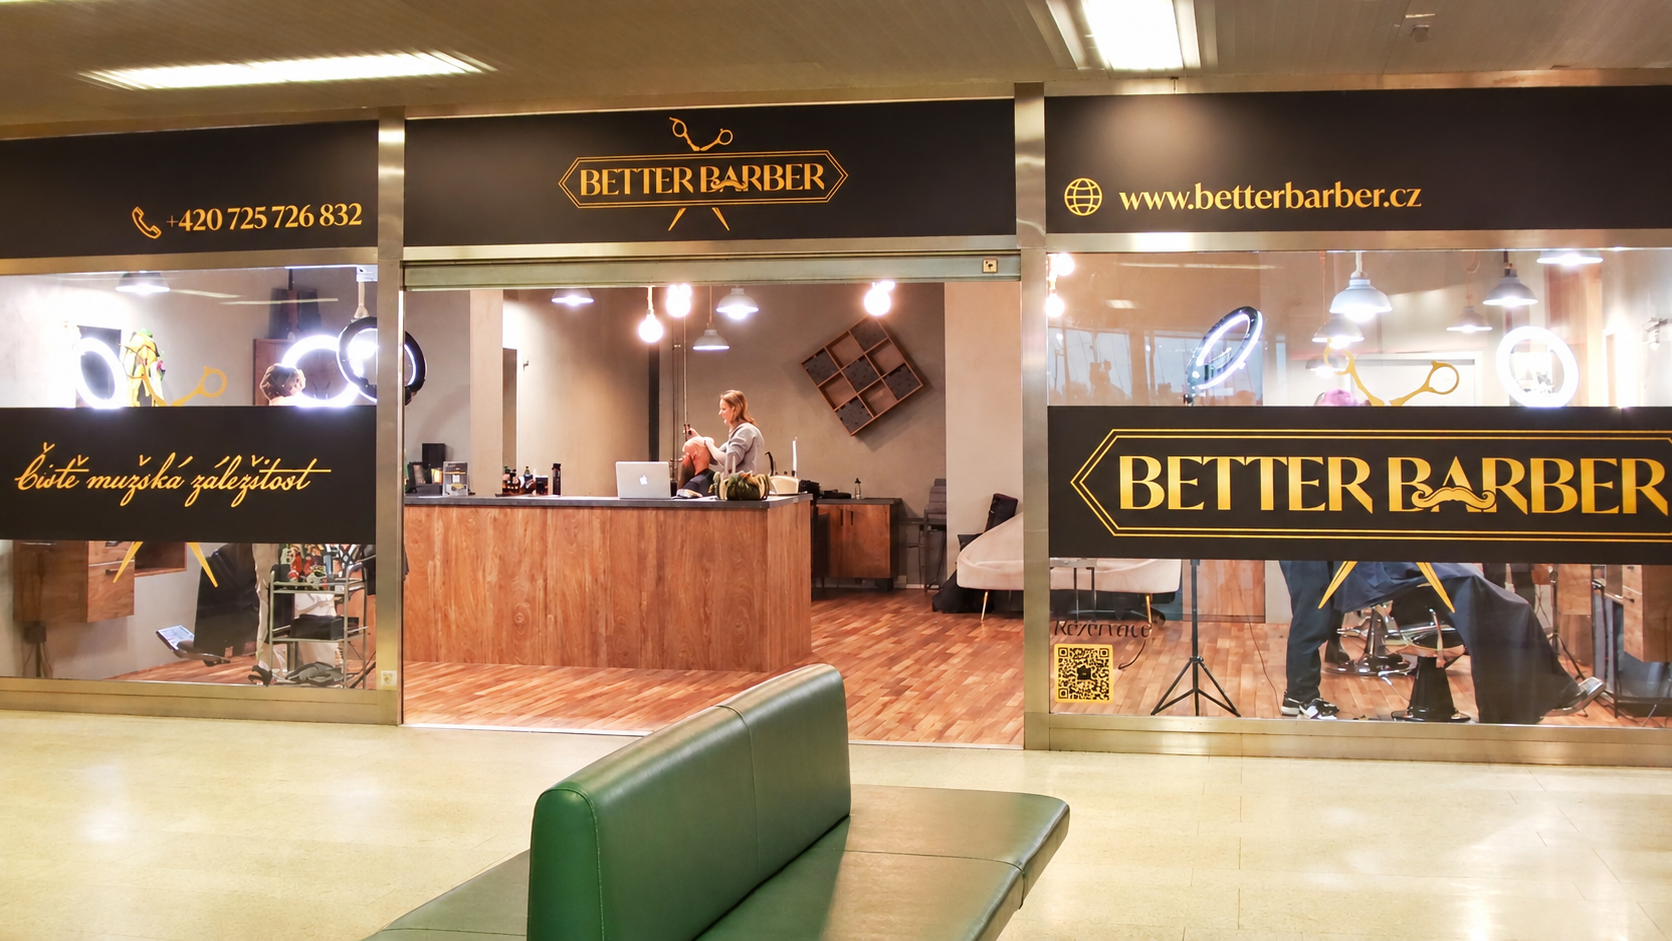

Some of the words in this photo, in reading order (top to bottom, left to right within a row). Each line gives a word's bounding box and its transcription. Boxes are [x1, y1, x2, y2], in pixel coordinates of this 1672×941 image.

[580, 166, 694, 196] BETTER
[700, 163, 825, 193] BARBER
[1119, 180, 1422, 211] www.betterbarber.cz
[166, 208, 222, 232] +420
[227, 206, 267, 230] 725
[272, 204, 314, 228] 726
[319, 202, 363, 227] 832
[14, 441, 89, 490] Čistě
[85, 452, 193, 507] mužská
[184, 454, 332, 508] záležitost
[1119, 455, 1374, 515] BETTER
[1388, 455, 1669, 517] BARBER
[1054, 619, 1152, 638] Rezervace
